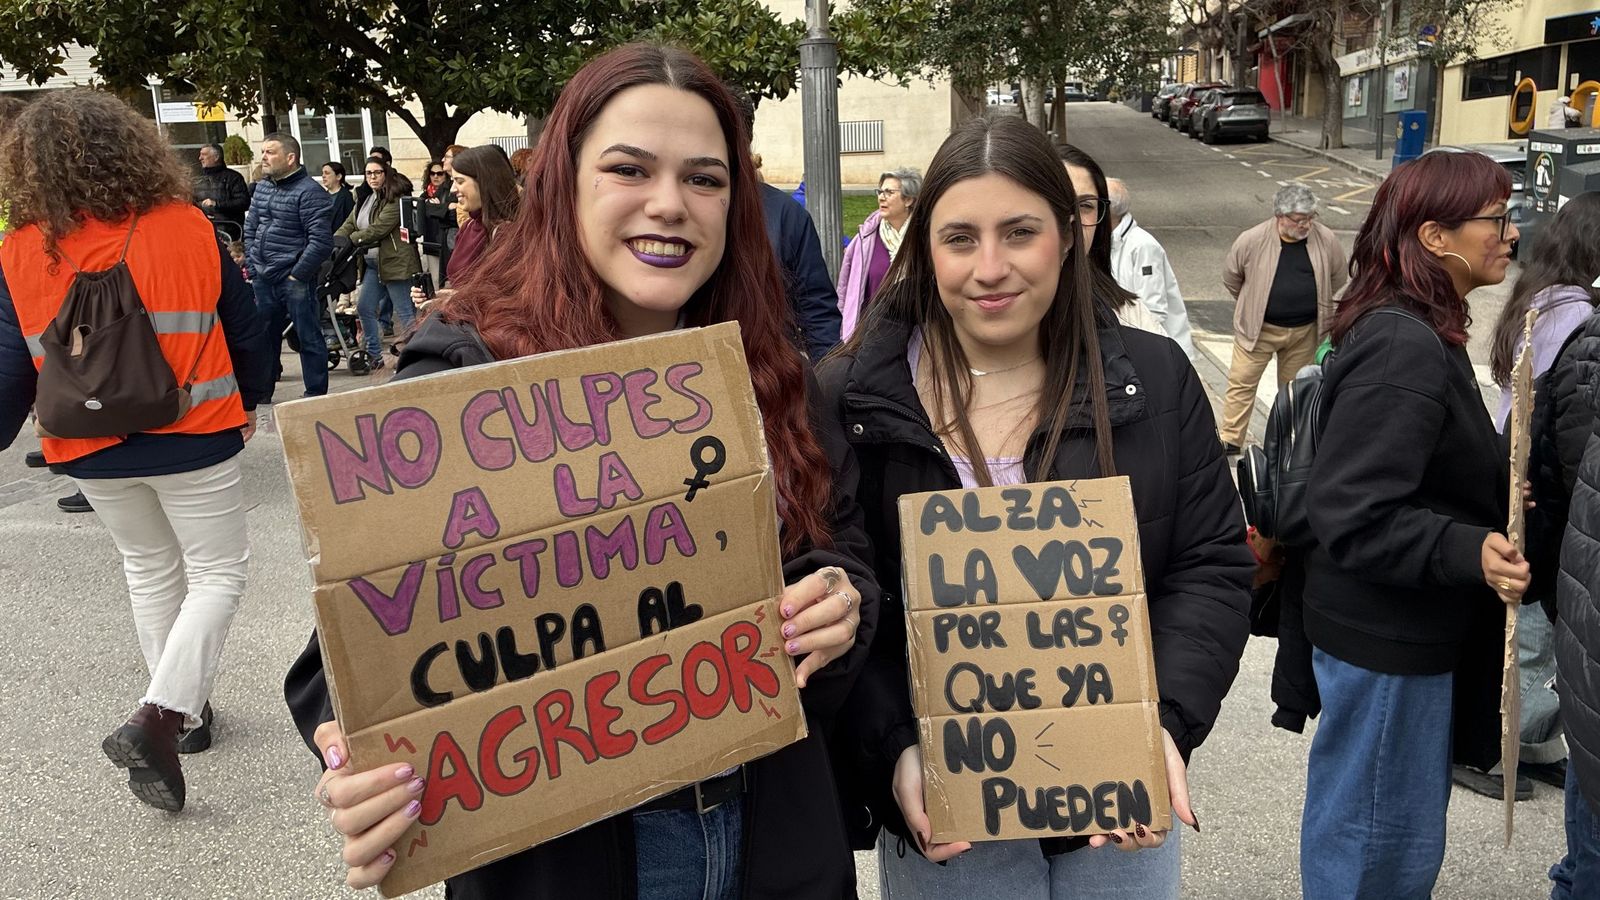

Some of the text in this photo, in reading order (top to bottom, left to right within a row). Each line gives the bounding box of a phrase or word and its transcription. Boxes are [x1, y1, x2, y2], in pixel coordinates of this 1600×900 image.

[317, 363, 713, 504] NO CULPES
[443, 451, 644, 549] A LA
[920, 487, 1082, 536] ALZA
[929, 537, 1123, 607] LA VOZ
[410, 581, 704, 708] CULPA AL
[932, 606, 1103, 653] POR LAS
[944, 662, 1113, 713] QUE YA
[418, 621, 780, 825] AGRESOR
[943, 717, 1017, 774] NO
[981, 777, 1152, 836] PUEDEN
